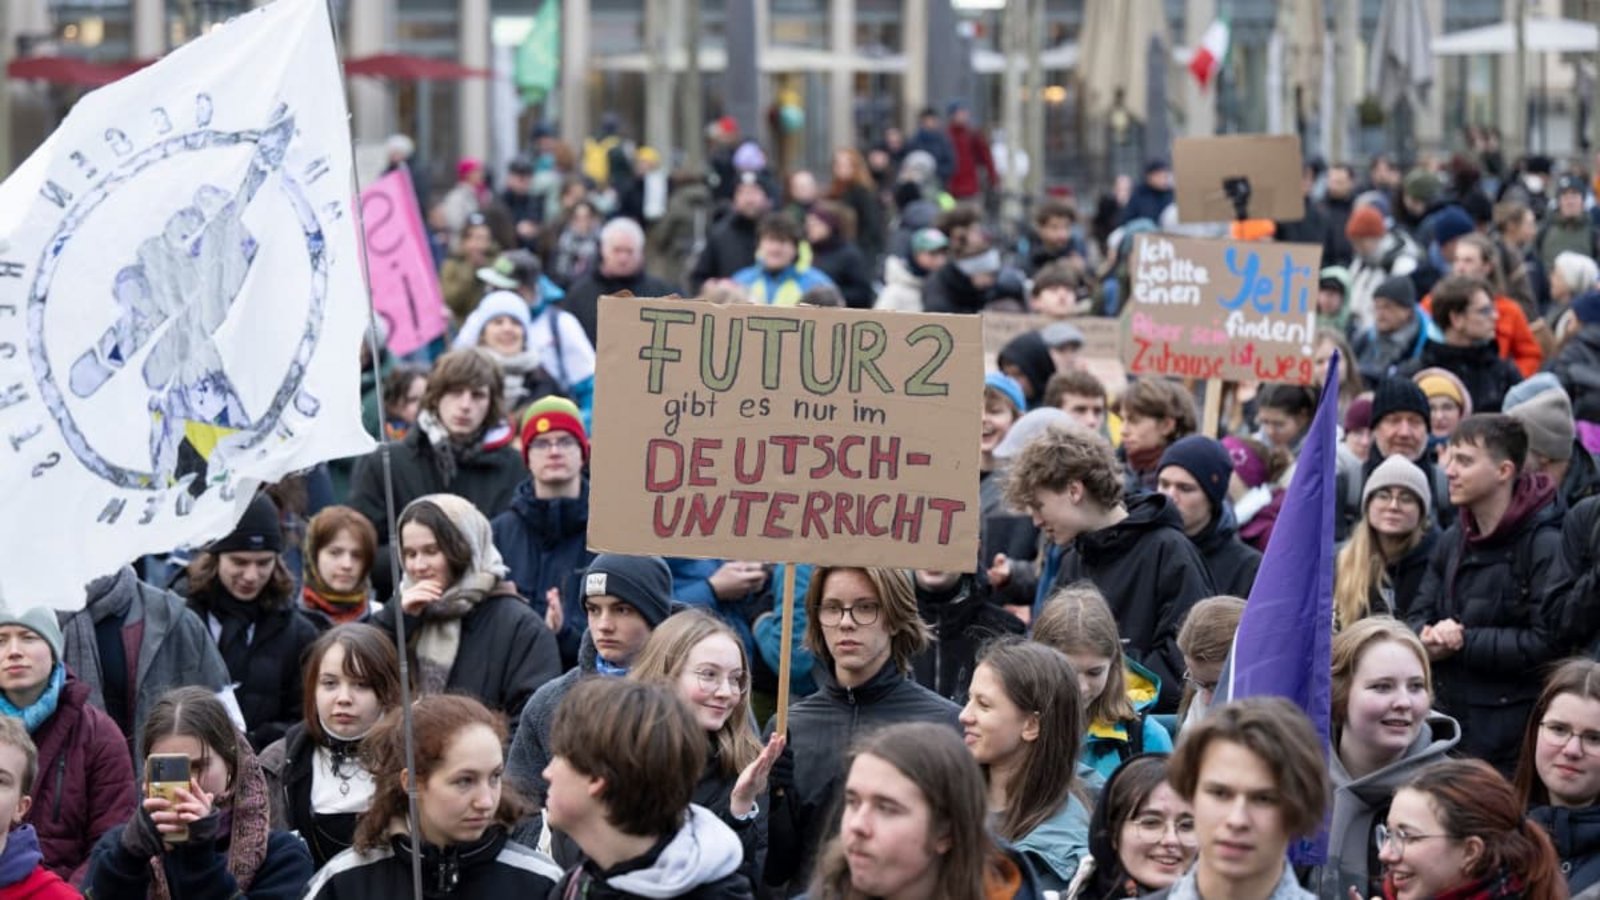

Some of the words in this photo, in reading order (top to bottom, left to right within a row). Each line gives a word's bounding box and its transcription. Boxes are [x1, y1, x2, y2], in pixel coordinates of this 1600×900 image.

[1140, 237, 1175, 263] Ich
[1133, 281, 1201, 305] einen
[1217, 246, 1312, 314] Yeti
[639, 308, 895, 396] FUTUR
[903, 323, 954, 396] 2
[1224, 310, 1316, 355] finden!
[1130, 337, 1224, 379] Zuhause
[1255, 356, 1314, 386] weg
[664, 390, 718, 436] gibt
[739, 396, 771, 418] es
[794, 398, 838, 421] nur
[853, 399, 886, 424] im
[645, 435, 932, 493] DEUTSCH-
[652, 490, 966, 545] UNTERRICHT
